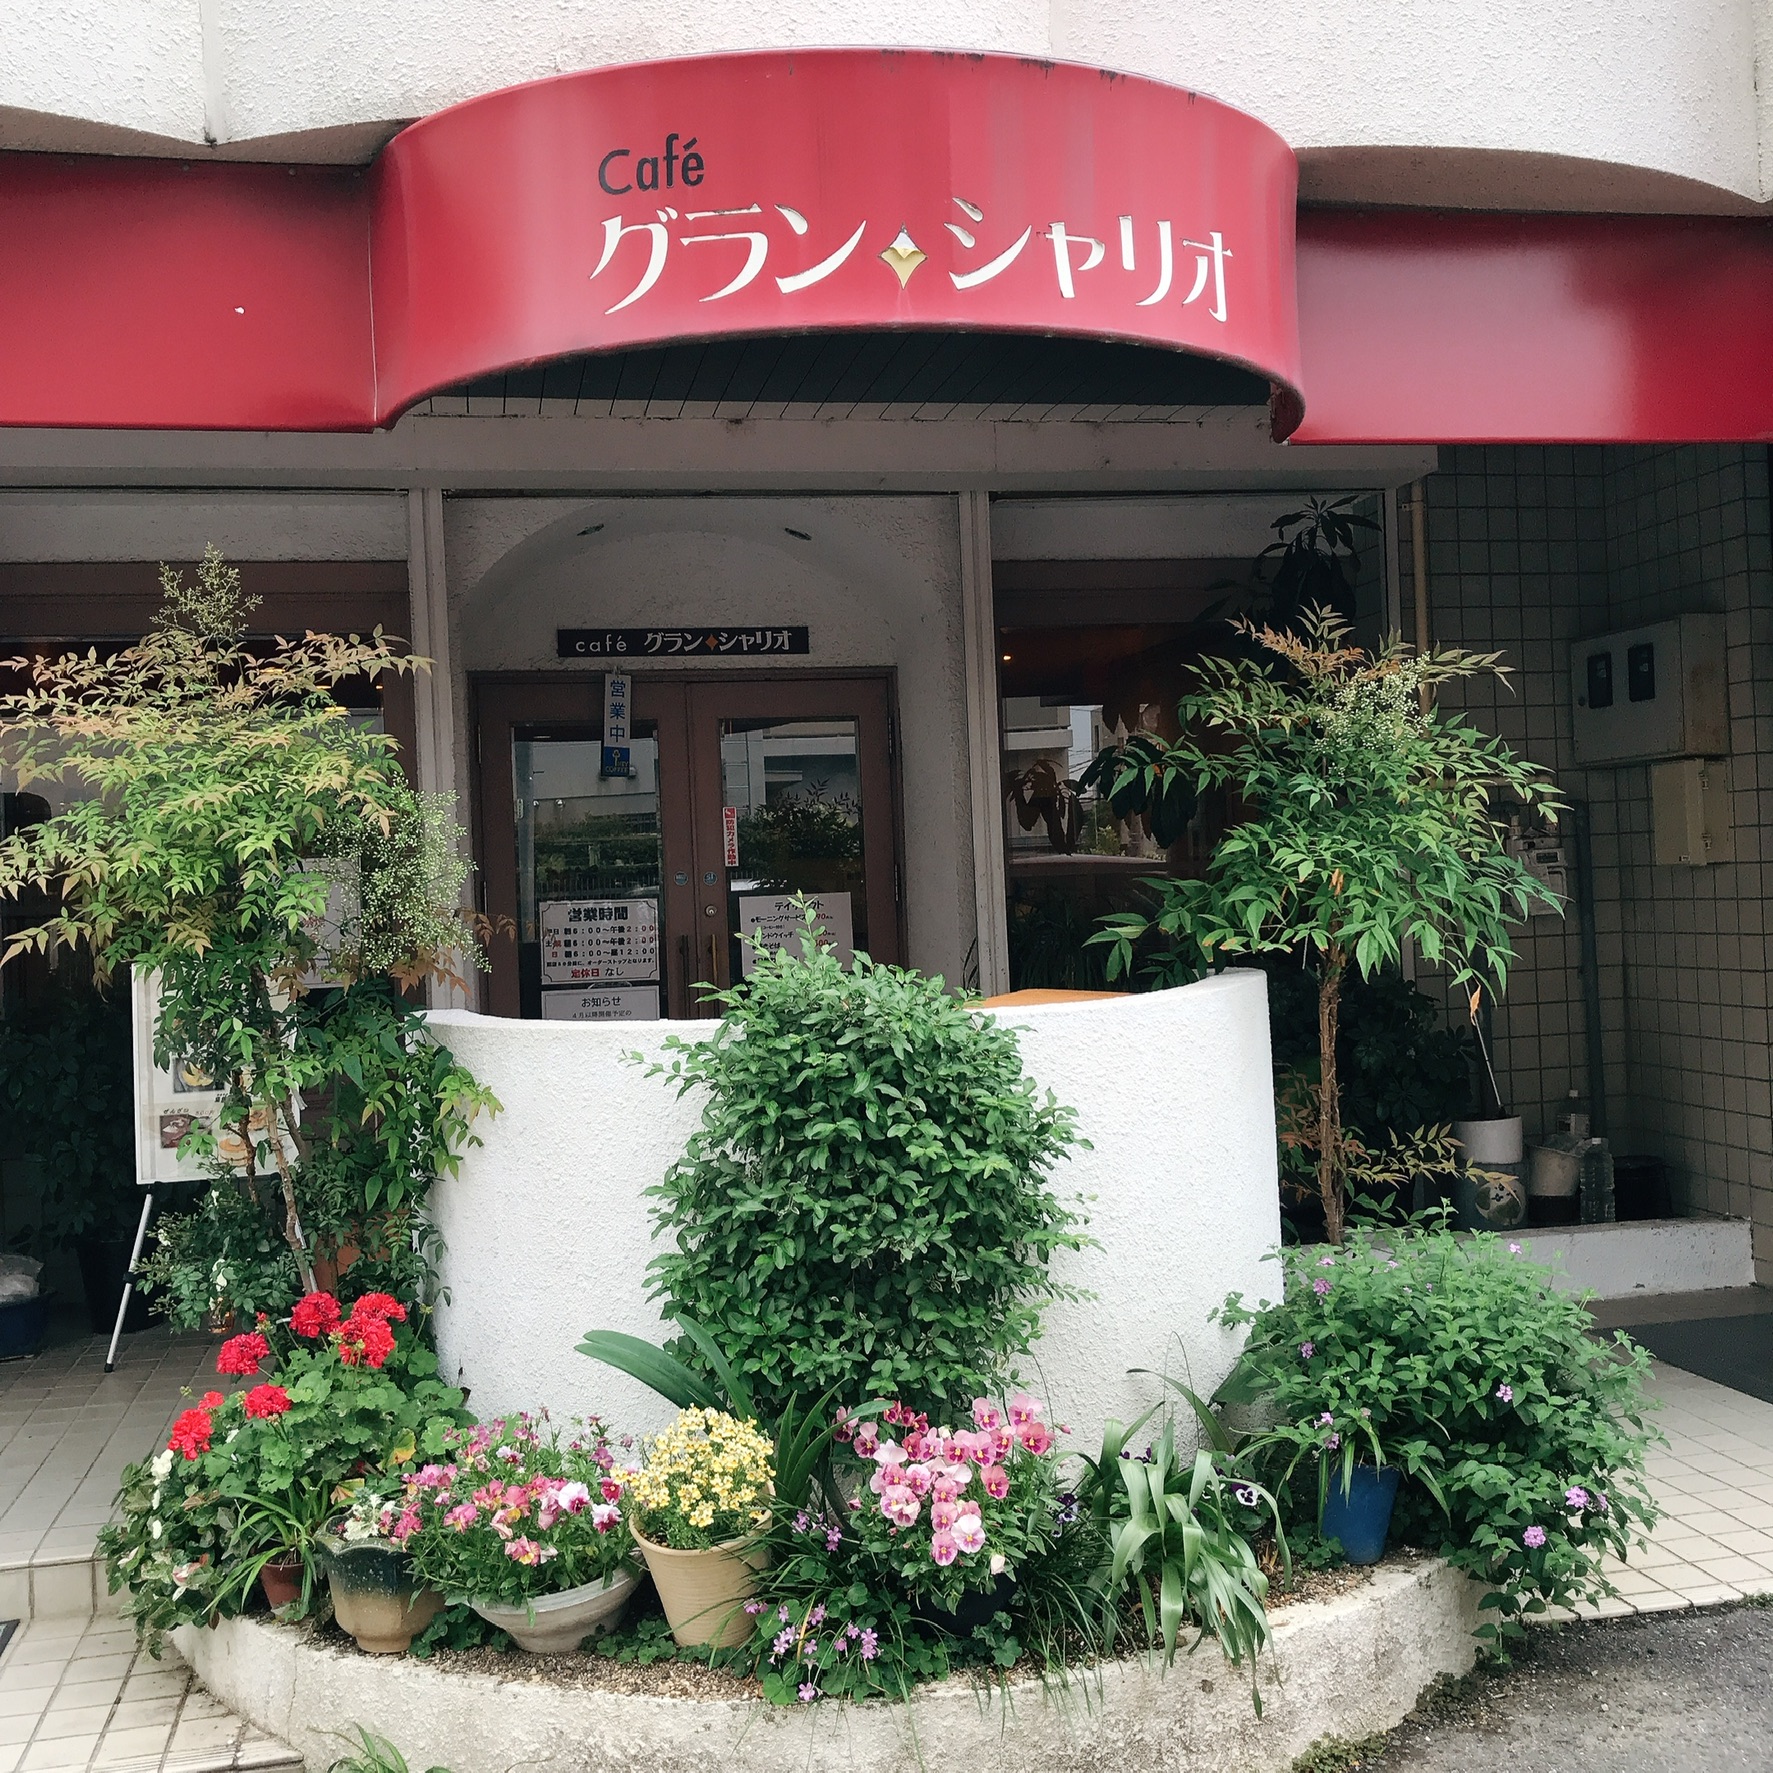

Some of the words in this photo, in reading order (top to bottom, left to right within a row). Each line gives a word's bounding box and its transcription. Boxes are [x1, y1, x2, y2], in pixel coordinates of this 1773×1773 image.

[598, 133, 705, 195] Café
[589, 202, 867, 315] グラン
[943, 197, 1233, 323] シャリオ
[575, 634, 627, 652] café
[644, 631, 703, 653] グラン
[718, 630, 792, 652] シャリオ
[610, 680, 625, 743] 営業中
[568, 906, 628, 922] 営業時間
[571, 968, 600, 978] 定休日
[605, 967, 624, 976] なし
[581, 996, 621, 1007] お知らせ
